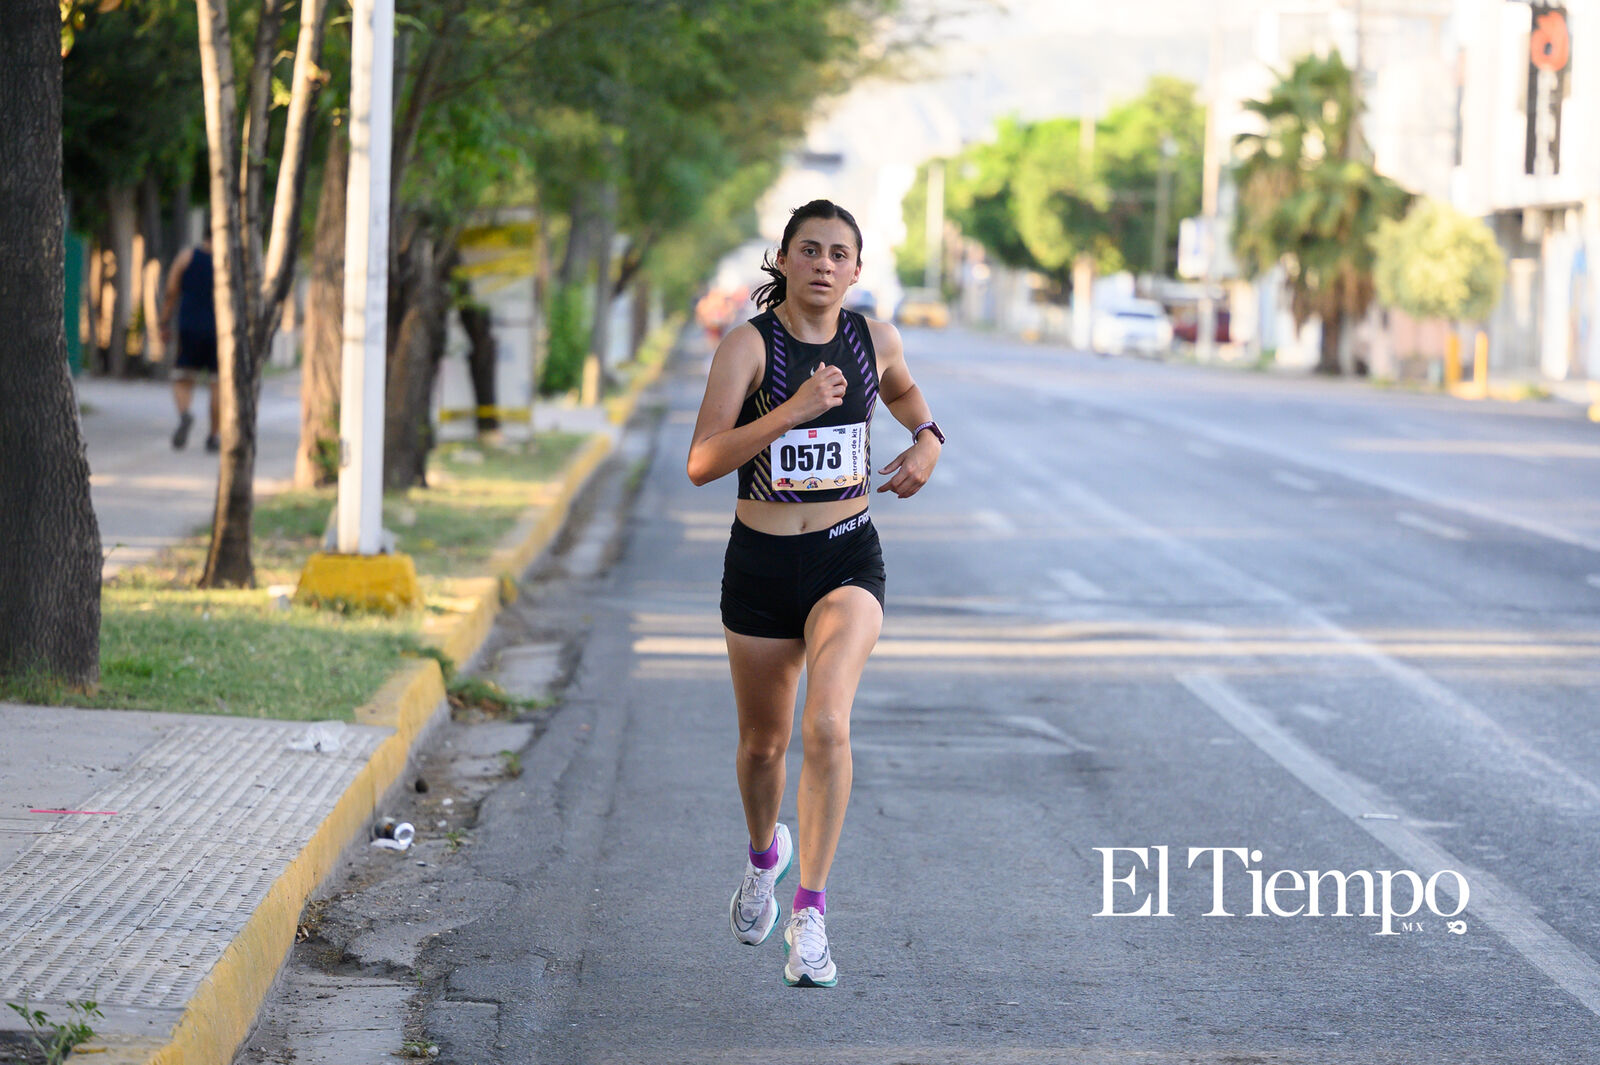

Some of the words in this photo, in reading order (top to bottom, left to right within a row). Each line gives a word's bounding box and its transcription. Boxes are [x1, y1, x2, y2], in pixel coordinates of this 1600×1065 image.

[851, 439, 857, 449] de
[780, 441, 842, 472] 0573
[828, 518, 857, 540] NIKE
